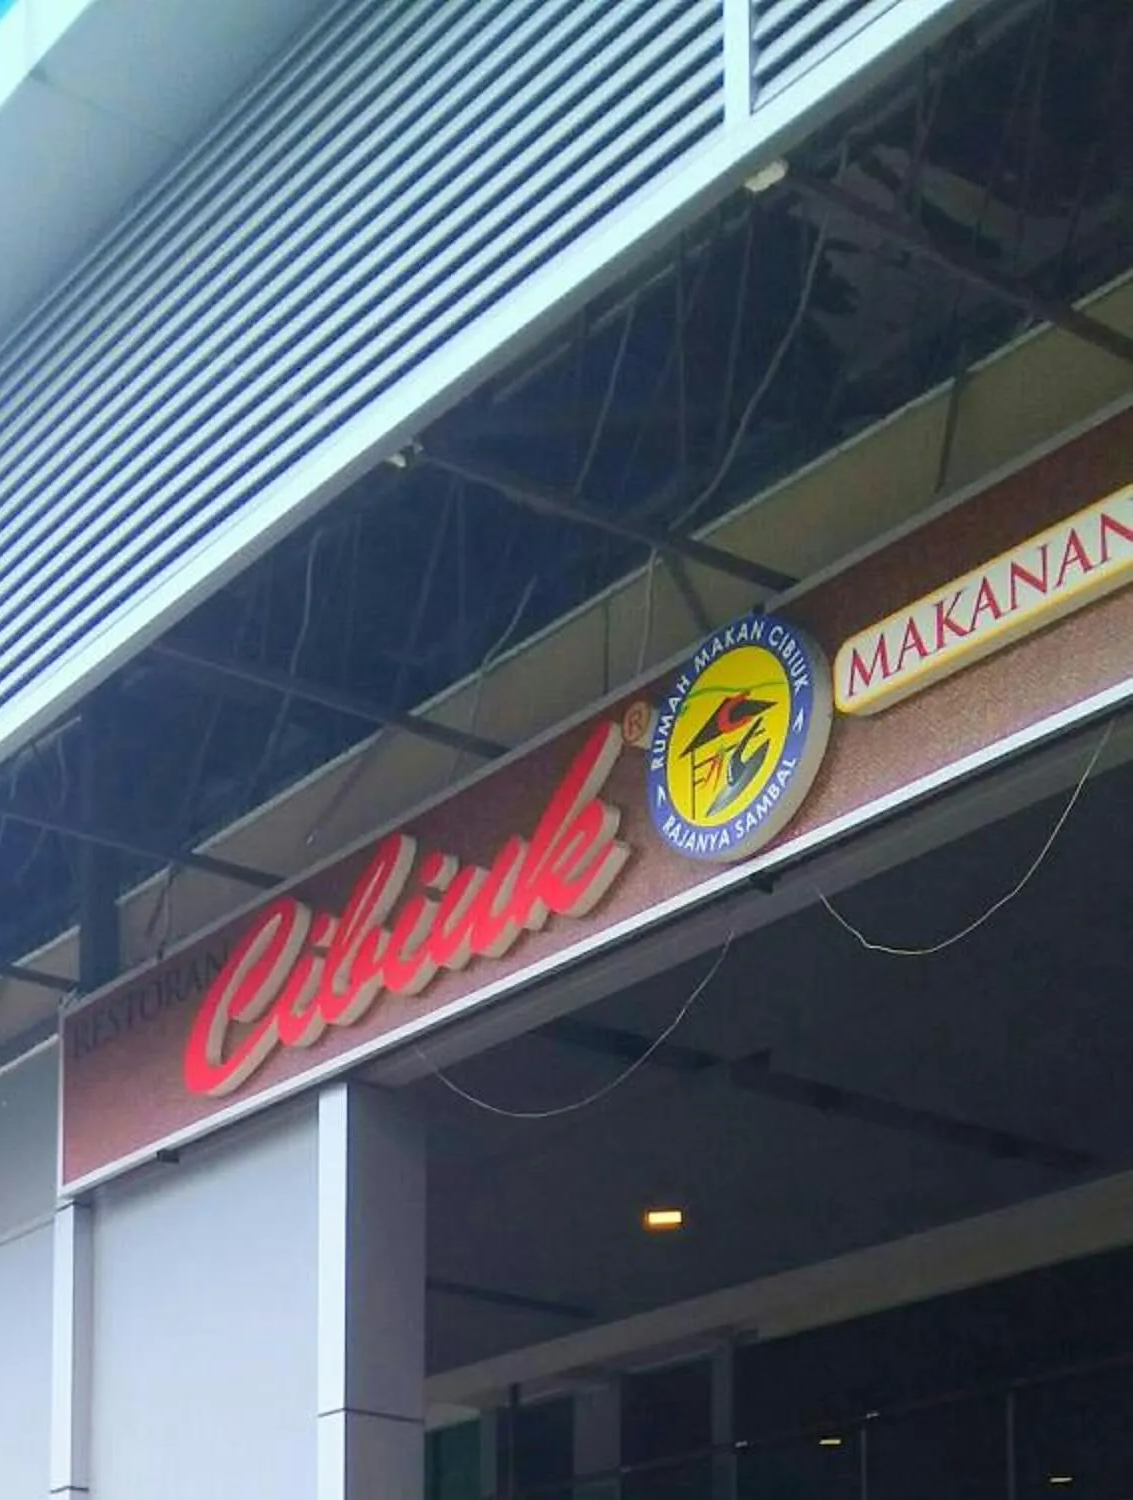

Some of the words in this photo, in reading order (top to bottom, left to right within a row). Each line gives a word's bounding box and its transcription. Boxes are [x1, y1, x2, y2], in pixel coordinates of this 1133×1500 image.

[847, 497, 1133, 698] MAKANAN
[650, 675, 691, 771] RUMAH
[693, 620, 764, 673] MAKAN
[768, 625, 809, 693] CIBIUK
[662, 815, 730, 853] RAJANYA
[735, 757, 797, 838] SAMBAL
[183, 720, 628, 1096] Cibiuk
